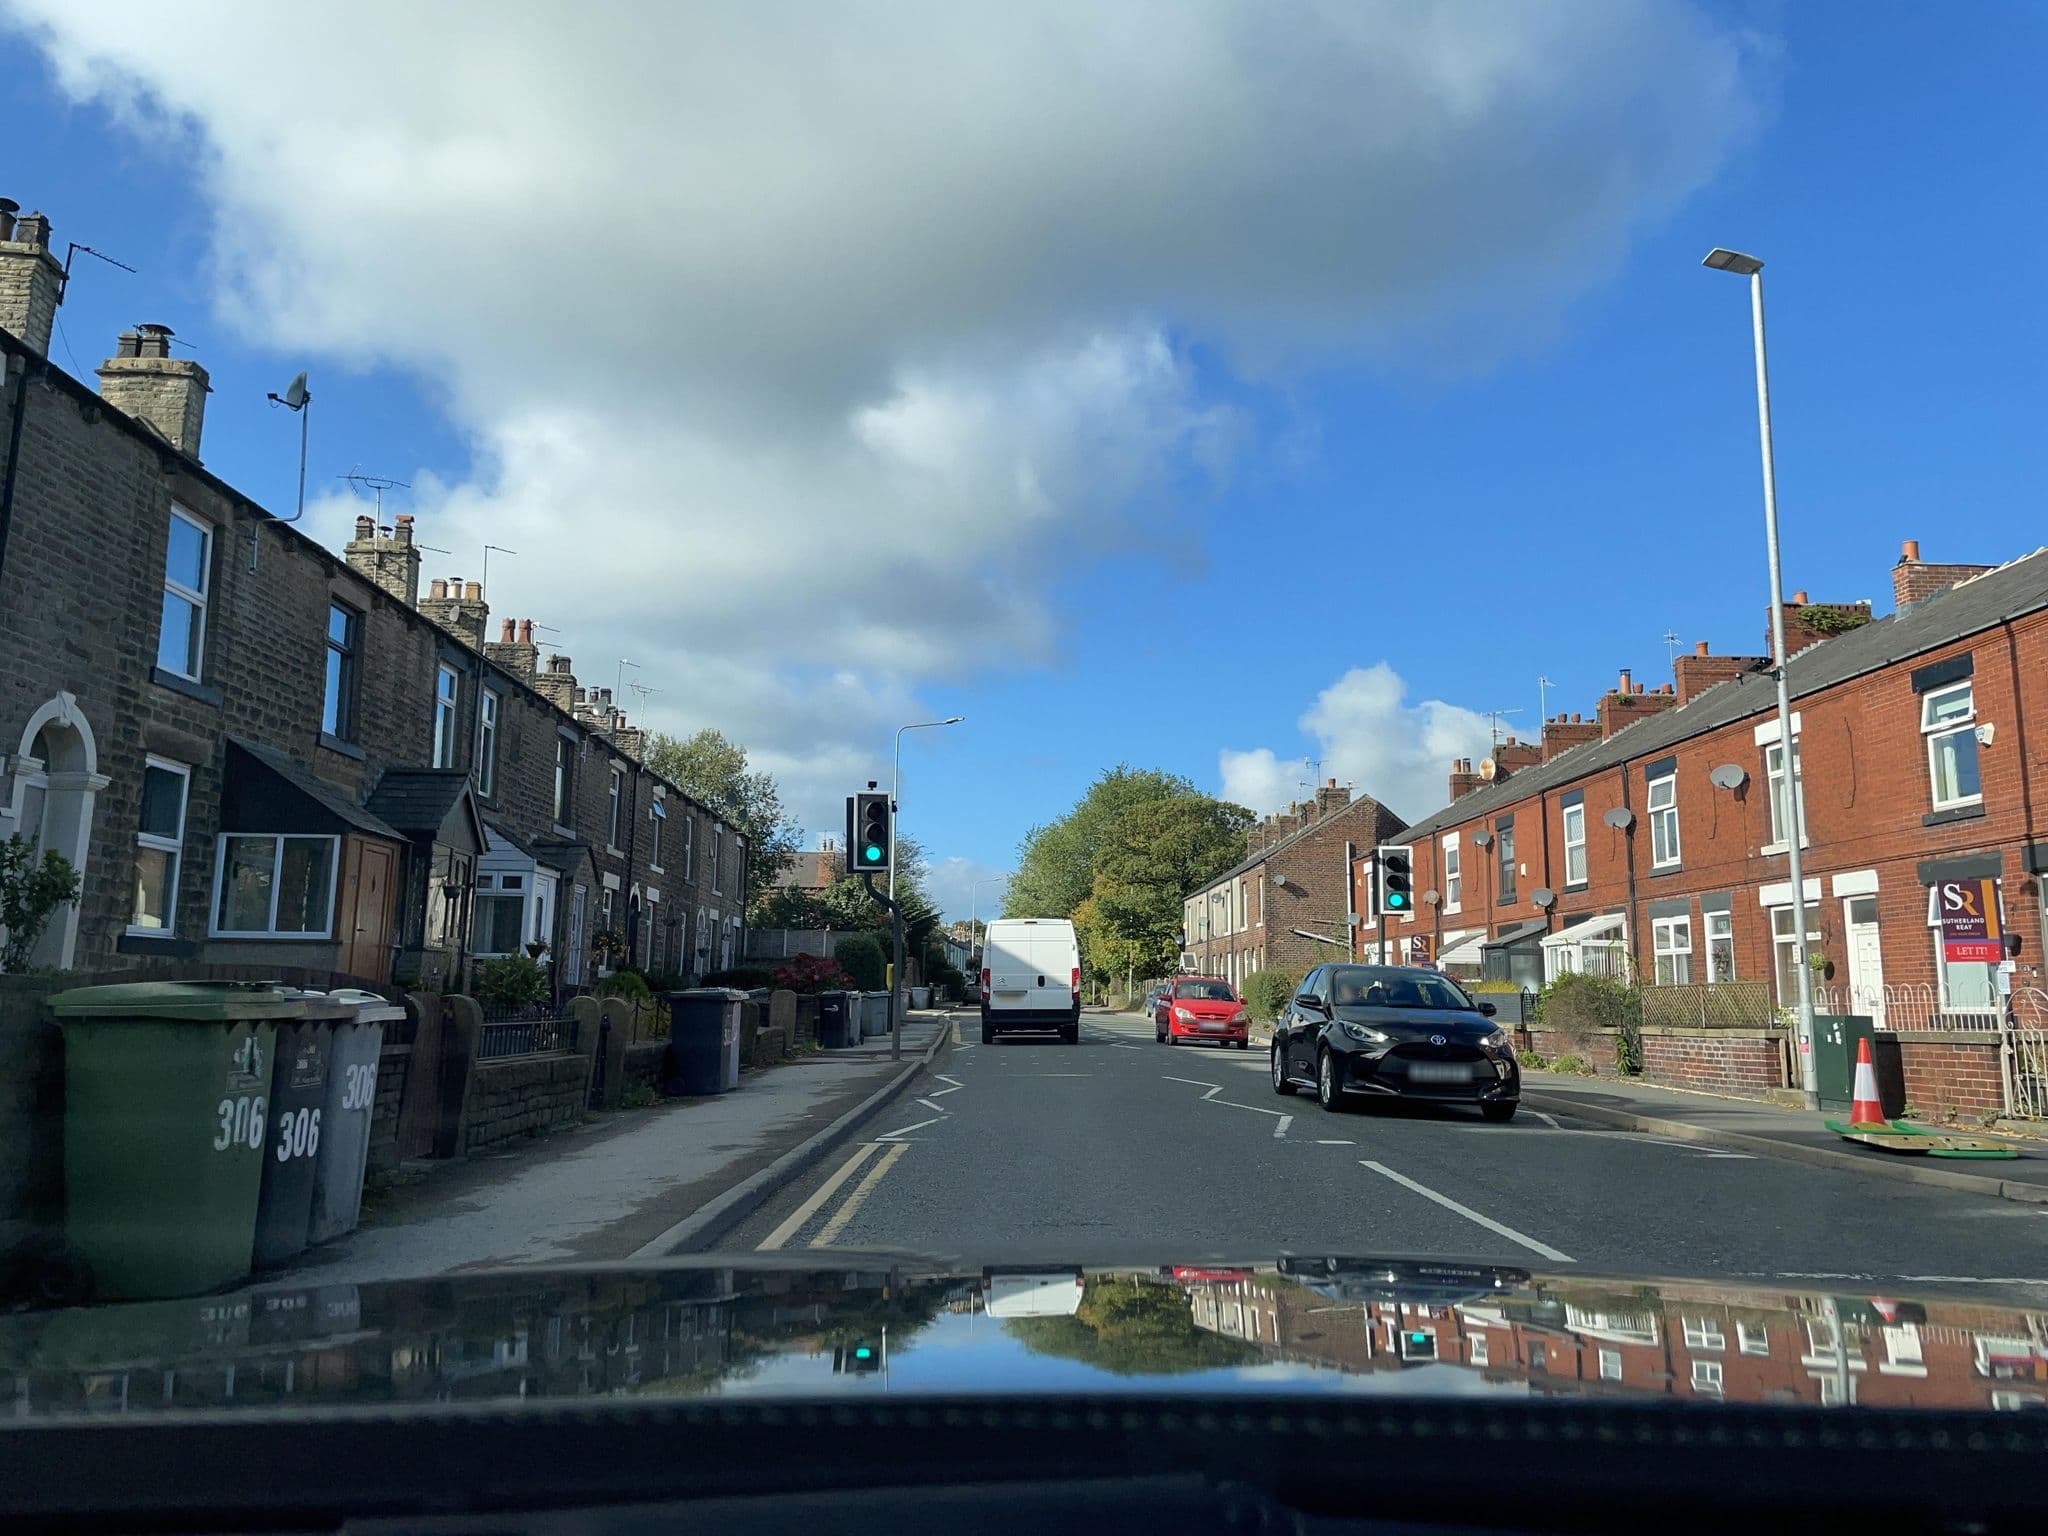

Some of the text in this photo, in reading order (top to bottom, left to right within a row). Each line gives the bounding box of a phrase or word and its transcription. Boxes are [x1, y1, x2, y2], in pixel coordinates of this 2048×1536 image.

[1943, 883, 1979, 915] SR
[1956, 946, 1988, 956] LET IT!
[342, 1063, 376, 1110] 306
[213, 1095, 266, 1151] 306
[277, 1107, 321, 1162] 306
